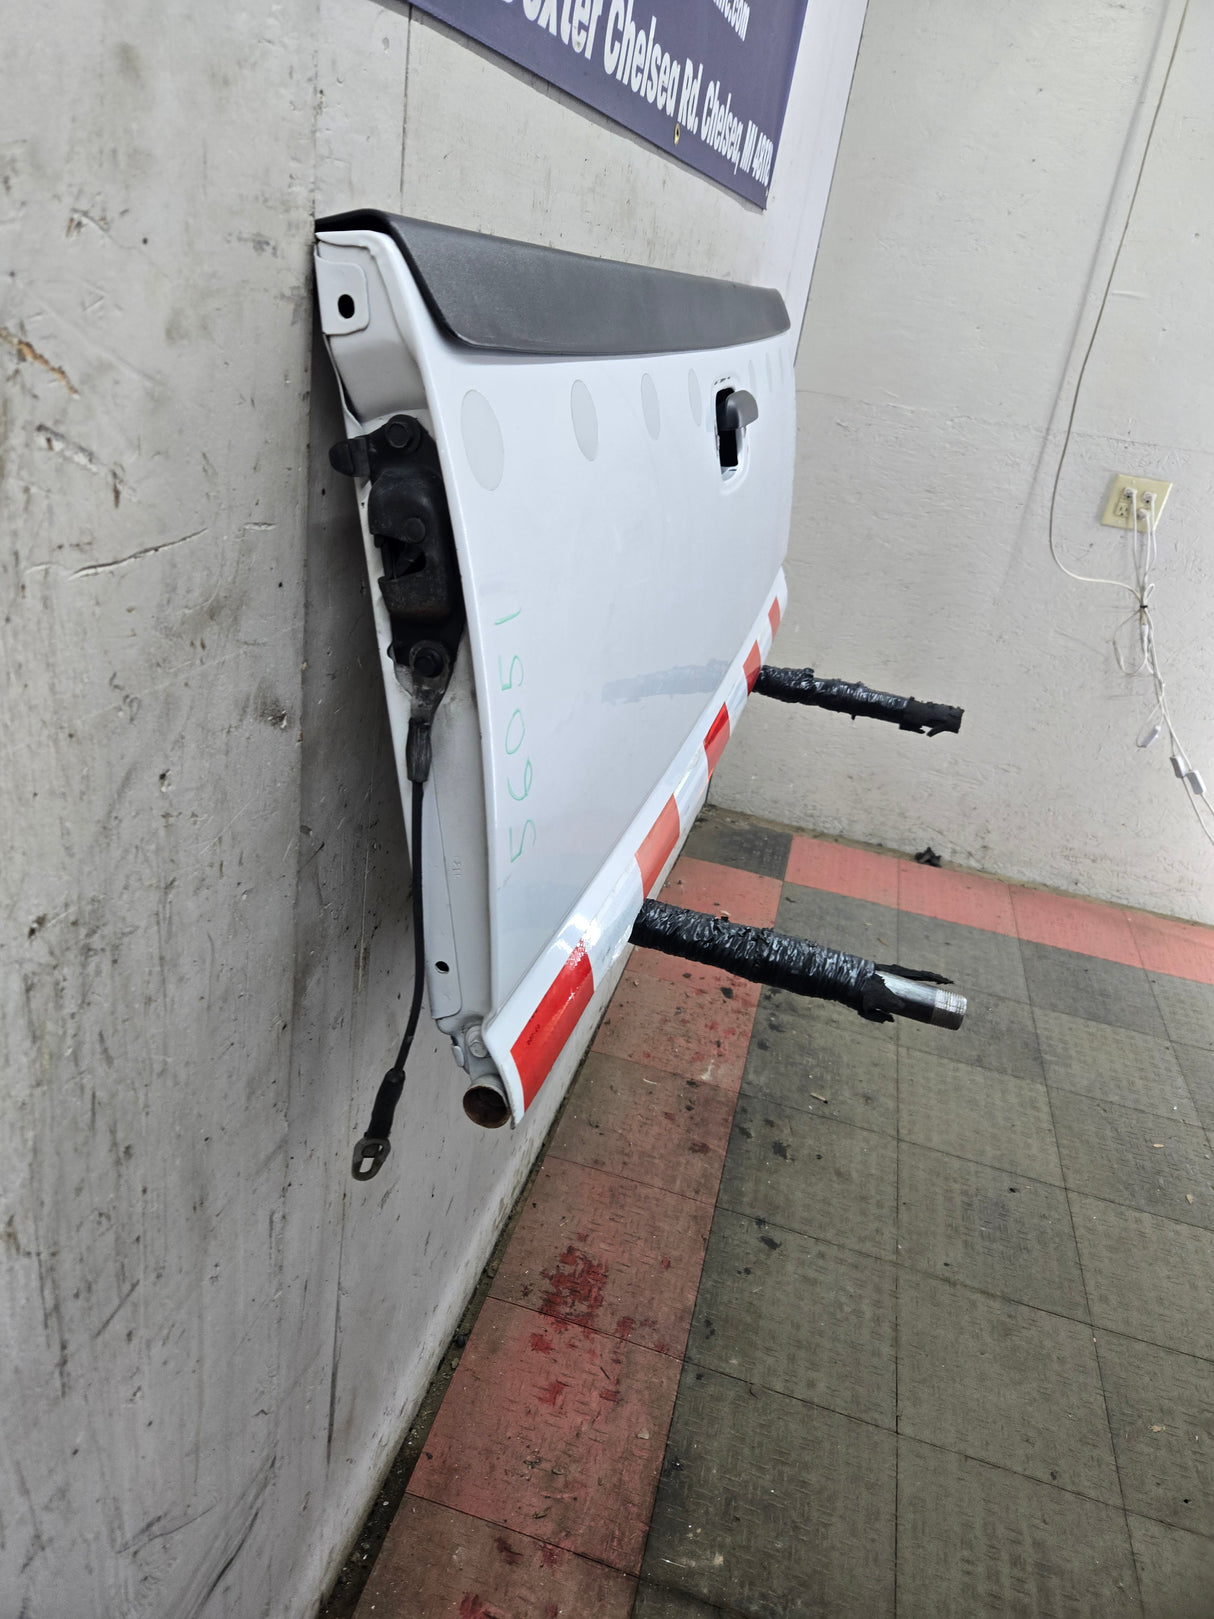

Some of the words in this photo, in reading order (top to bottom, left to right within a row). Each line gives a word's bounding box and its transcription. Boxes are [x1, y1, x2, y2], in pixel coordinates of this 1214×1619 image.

[603, 0, 681, 117] Chelsea
[677, 57, 703, 134] Rd.
[701, 80, 743, 175] Chelsea,
[740, 120, 758, 174] MI
[493, 606, 537, 863] 56051
